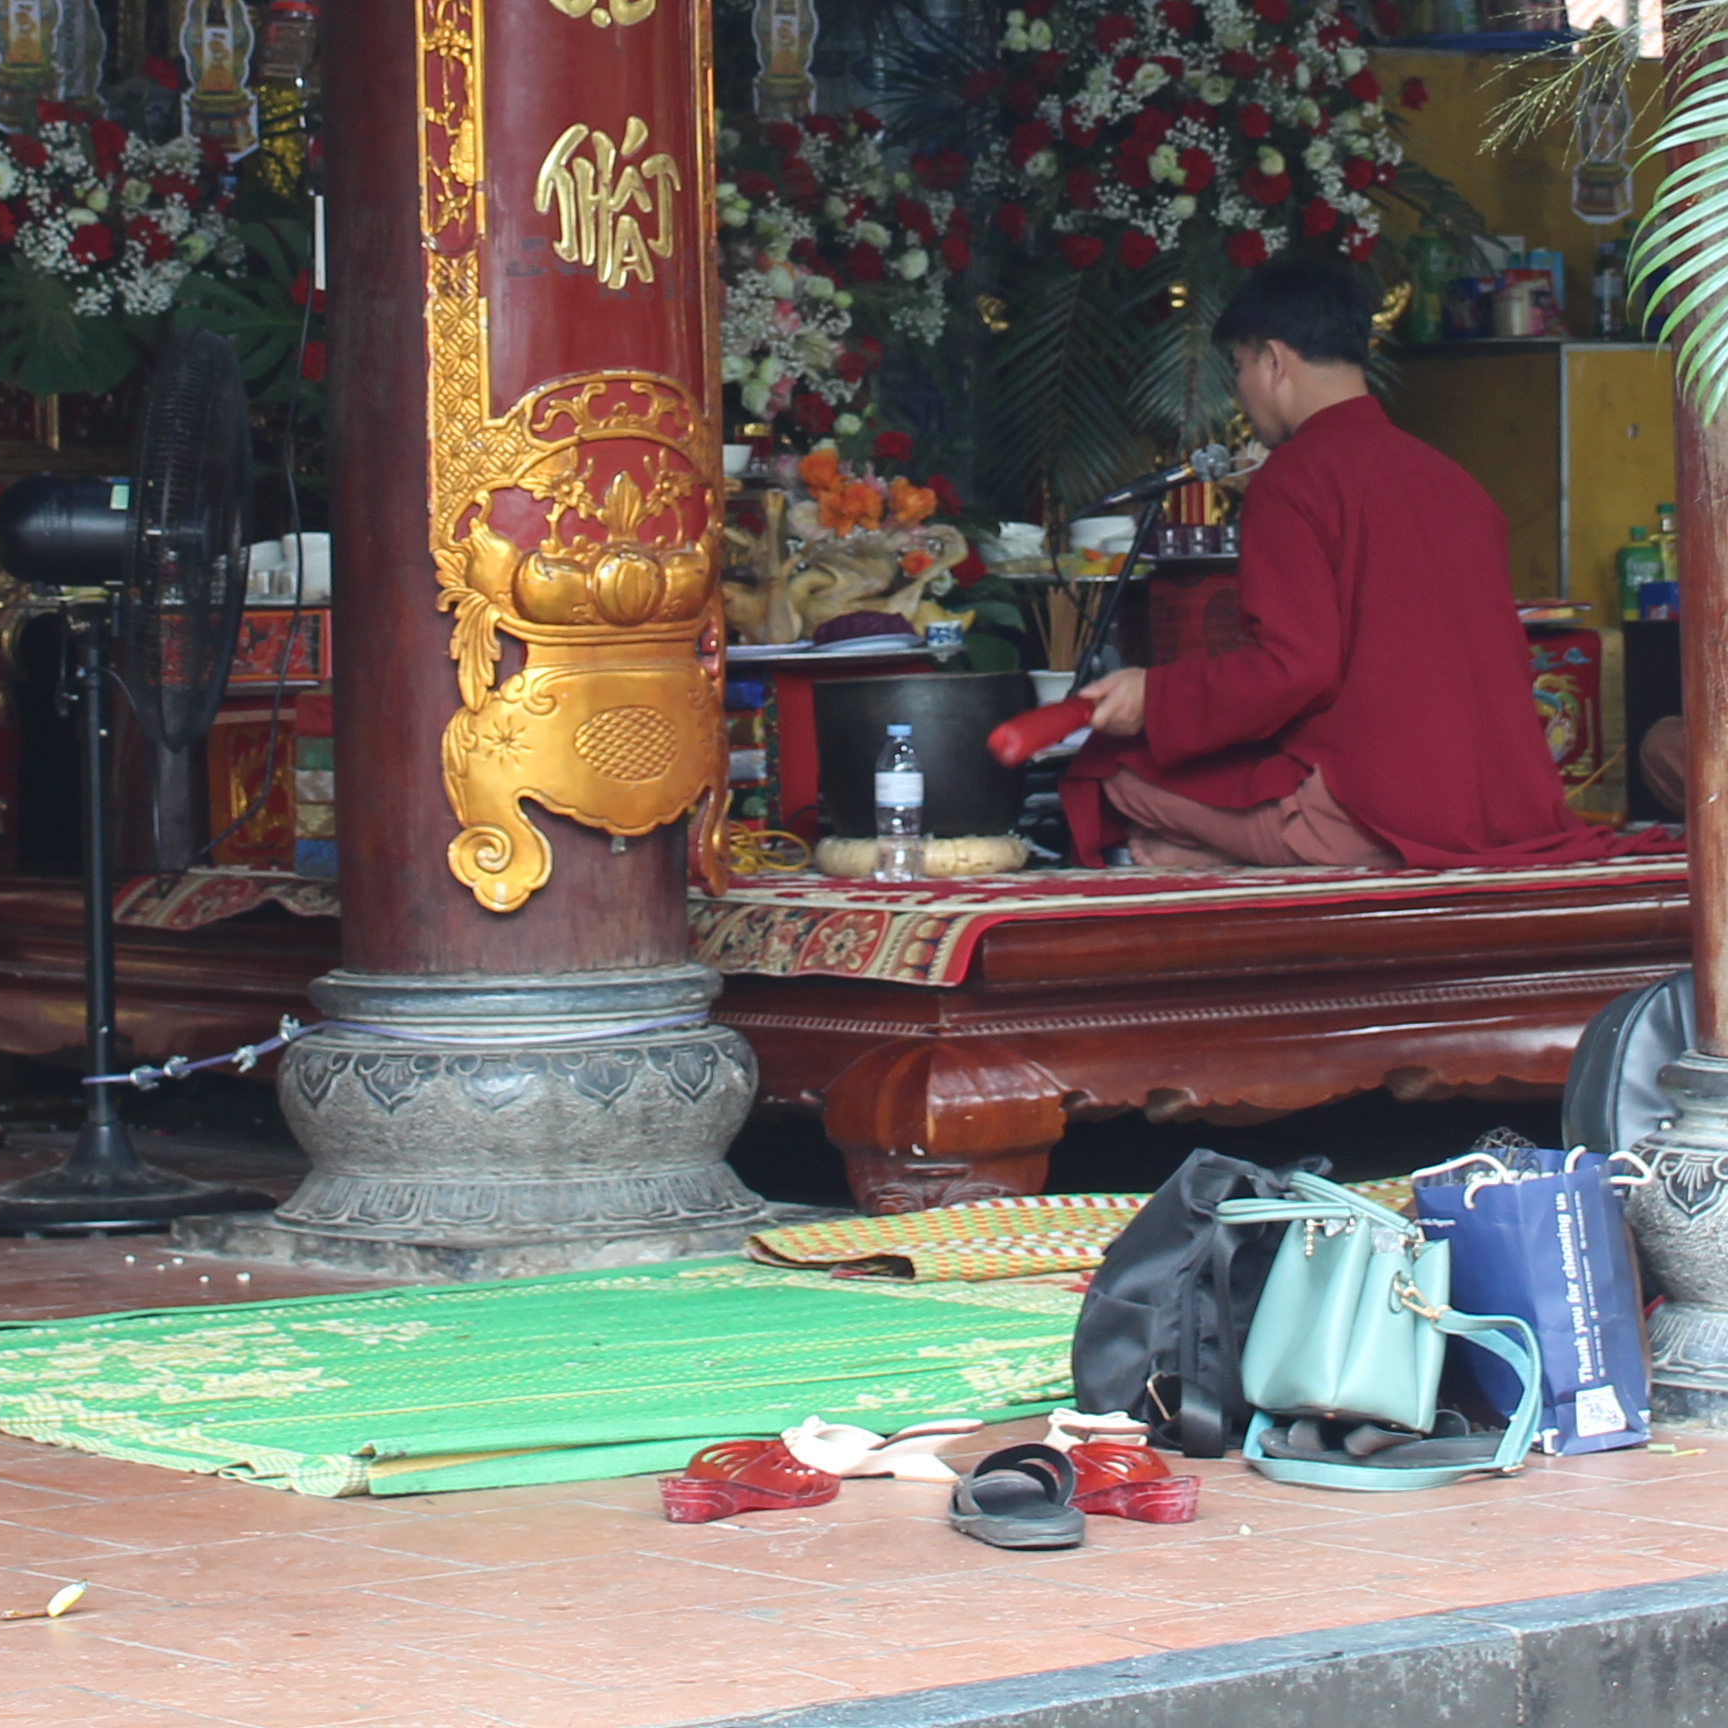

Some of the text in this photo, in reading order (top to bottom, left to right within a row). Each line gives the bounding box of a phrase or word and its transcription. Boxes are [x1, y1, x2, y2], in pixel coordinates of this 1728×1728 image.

[534, 116, 681, 288] THẤT
[1554, 1191, 1569, 1212] us
[1557, 1213, 1579, 1280] choosing
[1565, 1279, 1582, 1303] for
[1570, 1303, 1589, 1334] you
[1574, 1333, 1594, 1384] Thank
